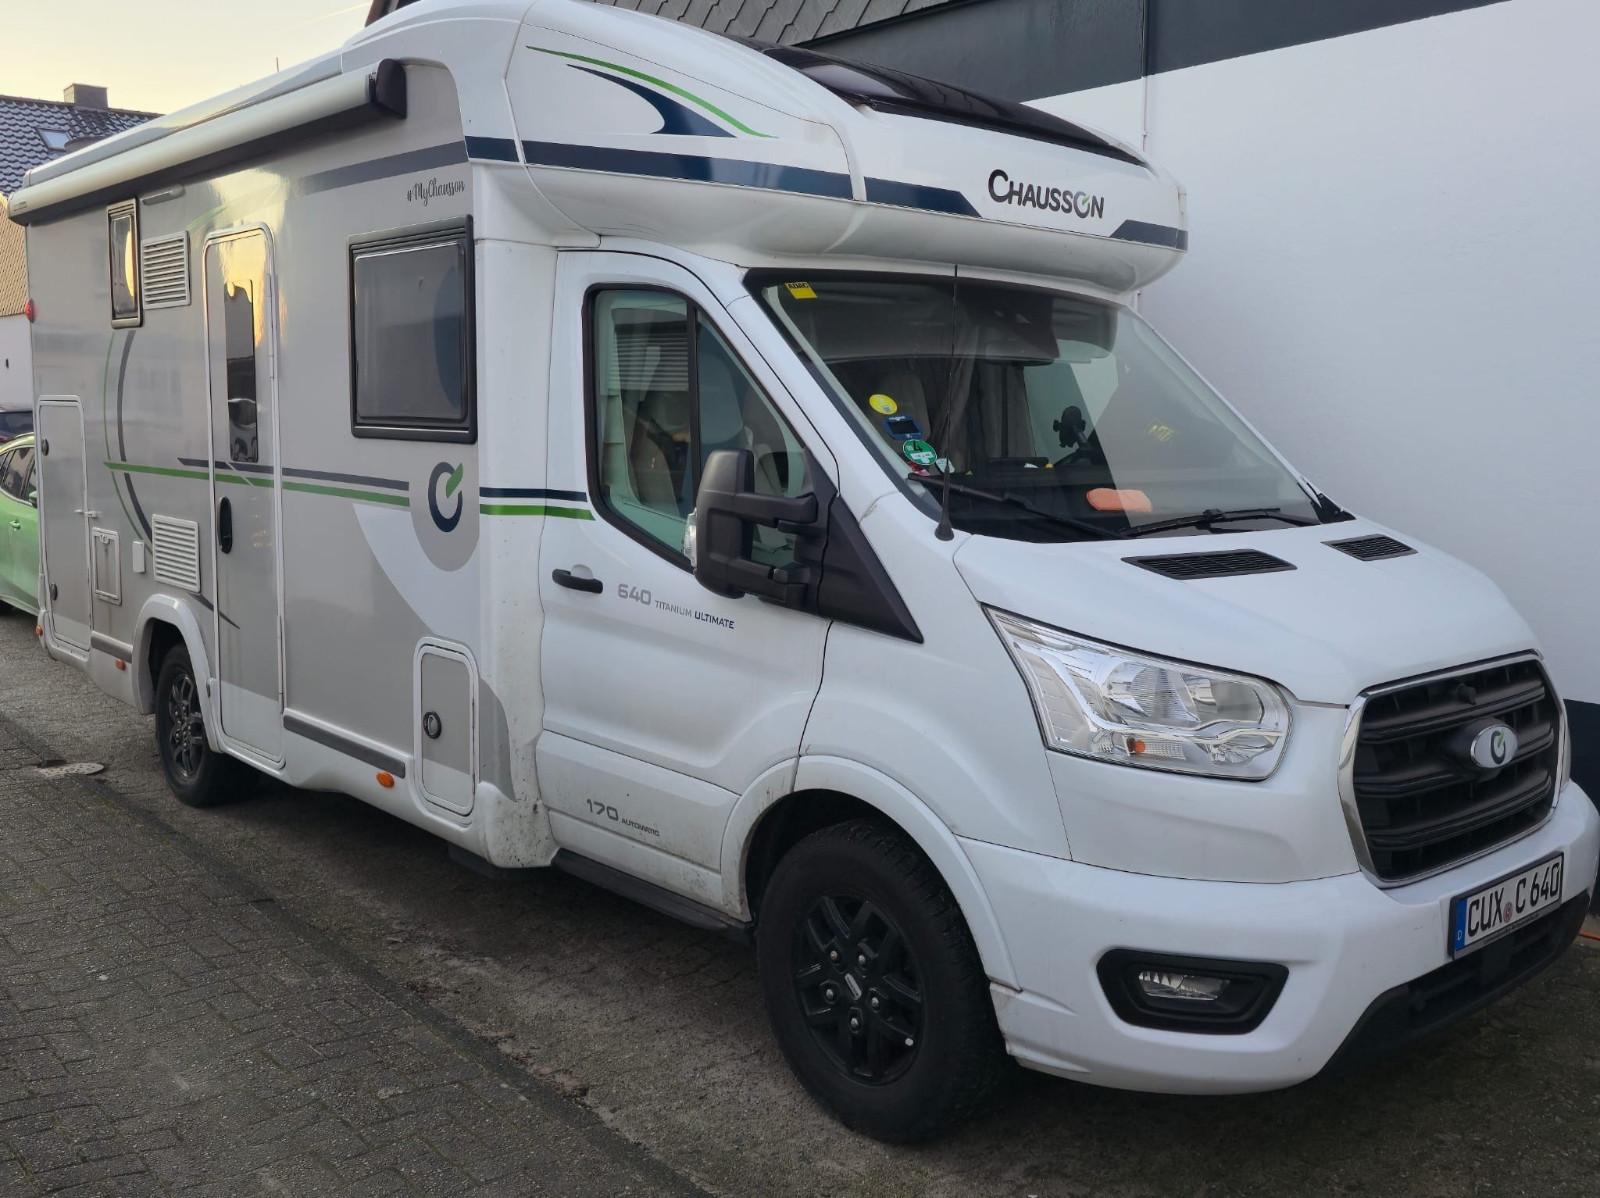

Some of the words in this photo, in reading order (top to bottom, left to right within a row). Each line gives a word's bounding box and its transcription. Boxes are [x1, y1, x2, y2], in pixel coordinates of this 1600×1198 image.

[988, 169, 1104, 219] CHAUSSON
[618, 583, 652, 605] 640
[655, 600, 692, 617] TITANIUM
[694, 611, 735, 629] ULTIMATE
[586, 798, 619, 821] 170
[1467, 887, 1504, 937] CUX
[1515, 878, 1526, 914] C
[1530, 862, 1560, 907] 640
